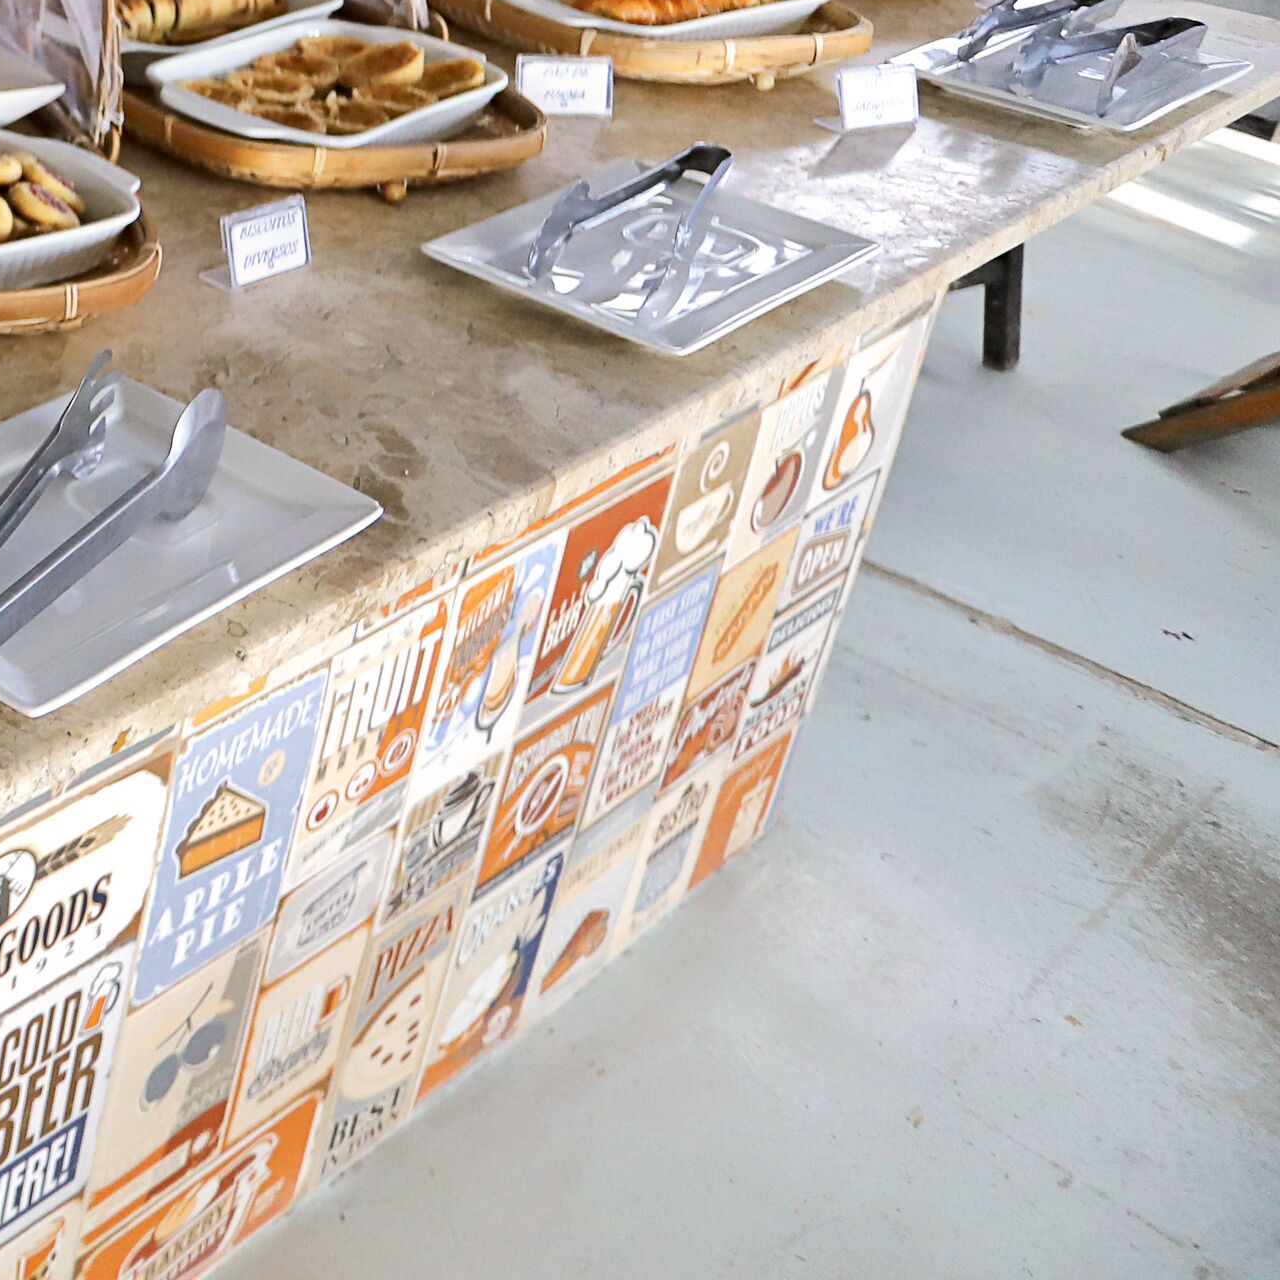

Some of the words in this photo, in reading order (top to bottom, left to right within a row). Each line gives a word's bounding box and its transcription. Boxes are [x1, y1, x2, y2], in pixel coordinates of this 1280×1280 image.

[796, 542, 842, 588] OPEN
[176, 689, 320, 802] HOMEMADE
[318, 626, 444, 762] FRUIT
[147, 836, 284, 949] APPLE
[170, 895, 246, 969] PIE
[367, 904, 455, 1002] PIZZA
